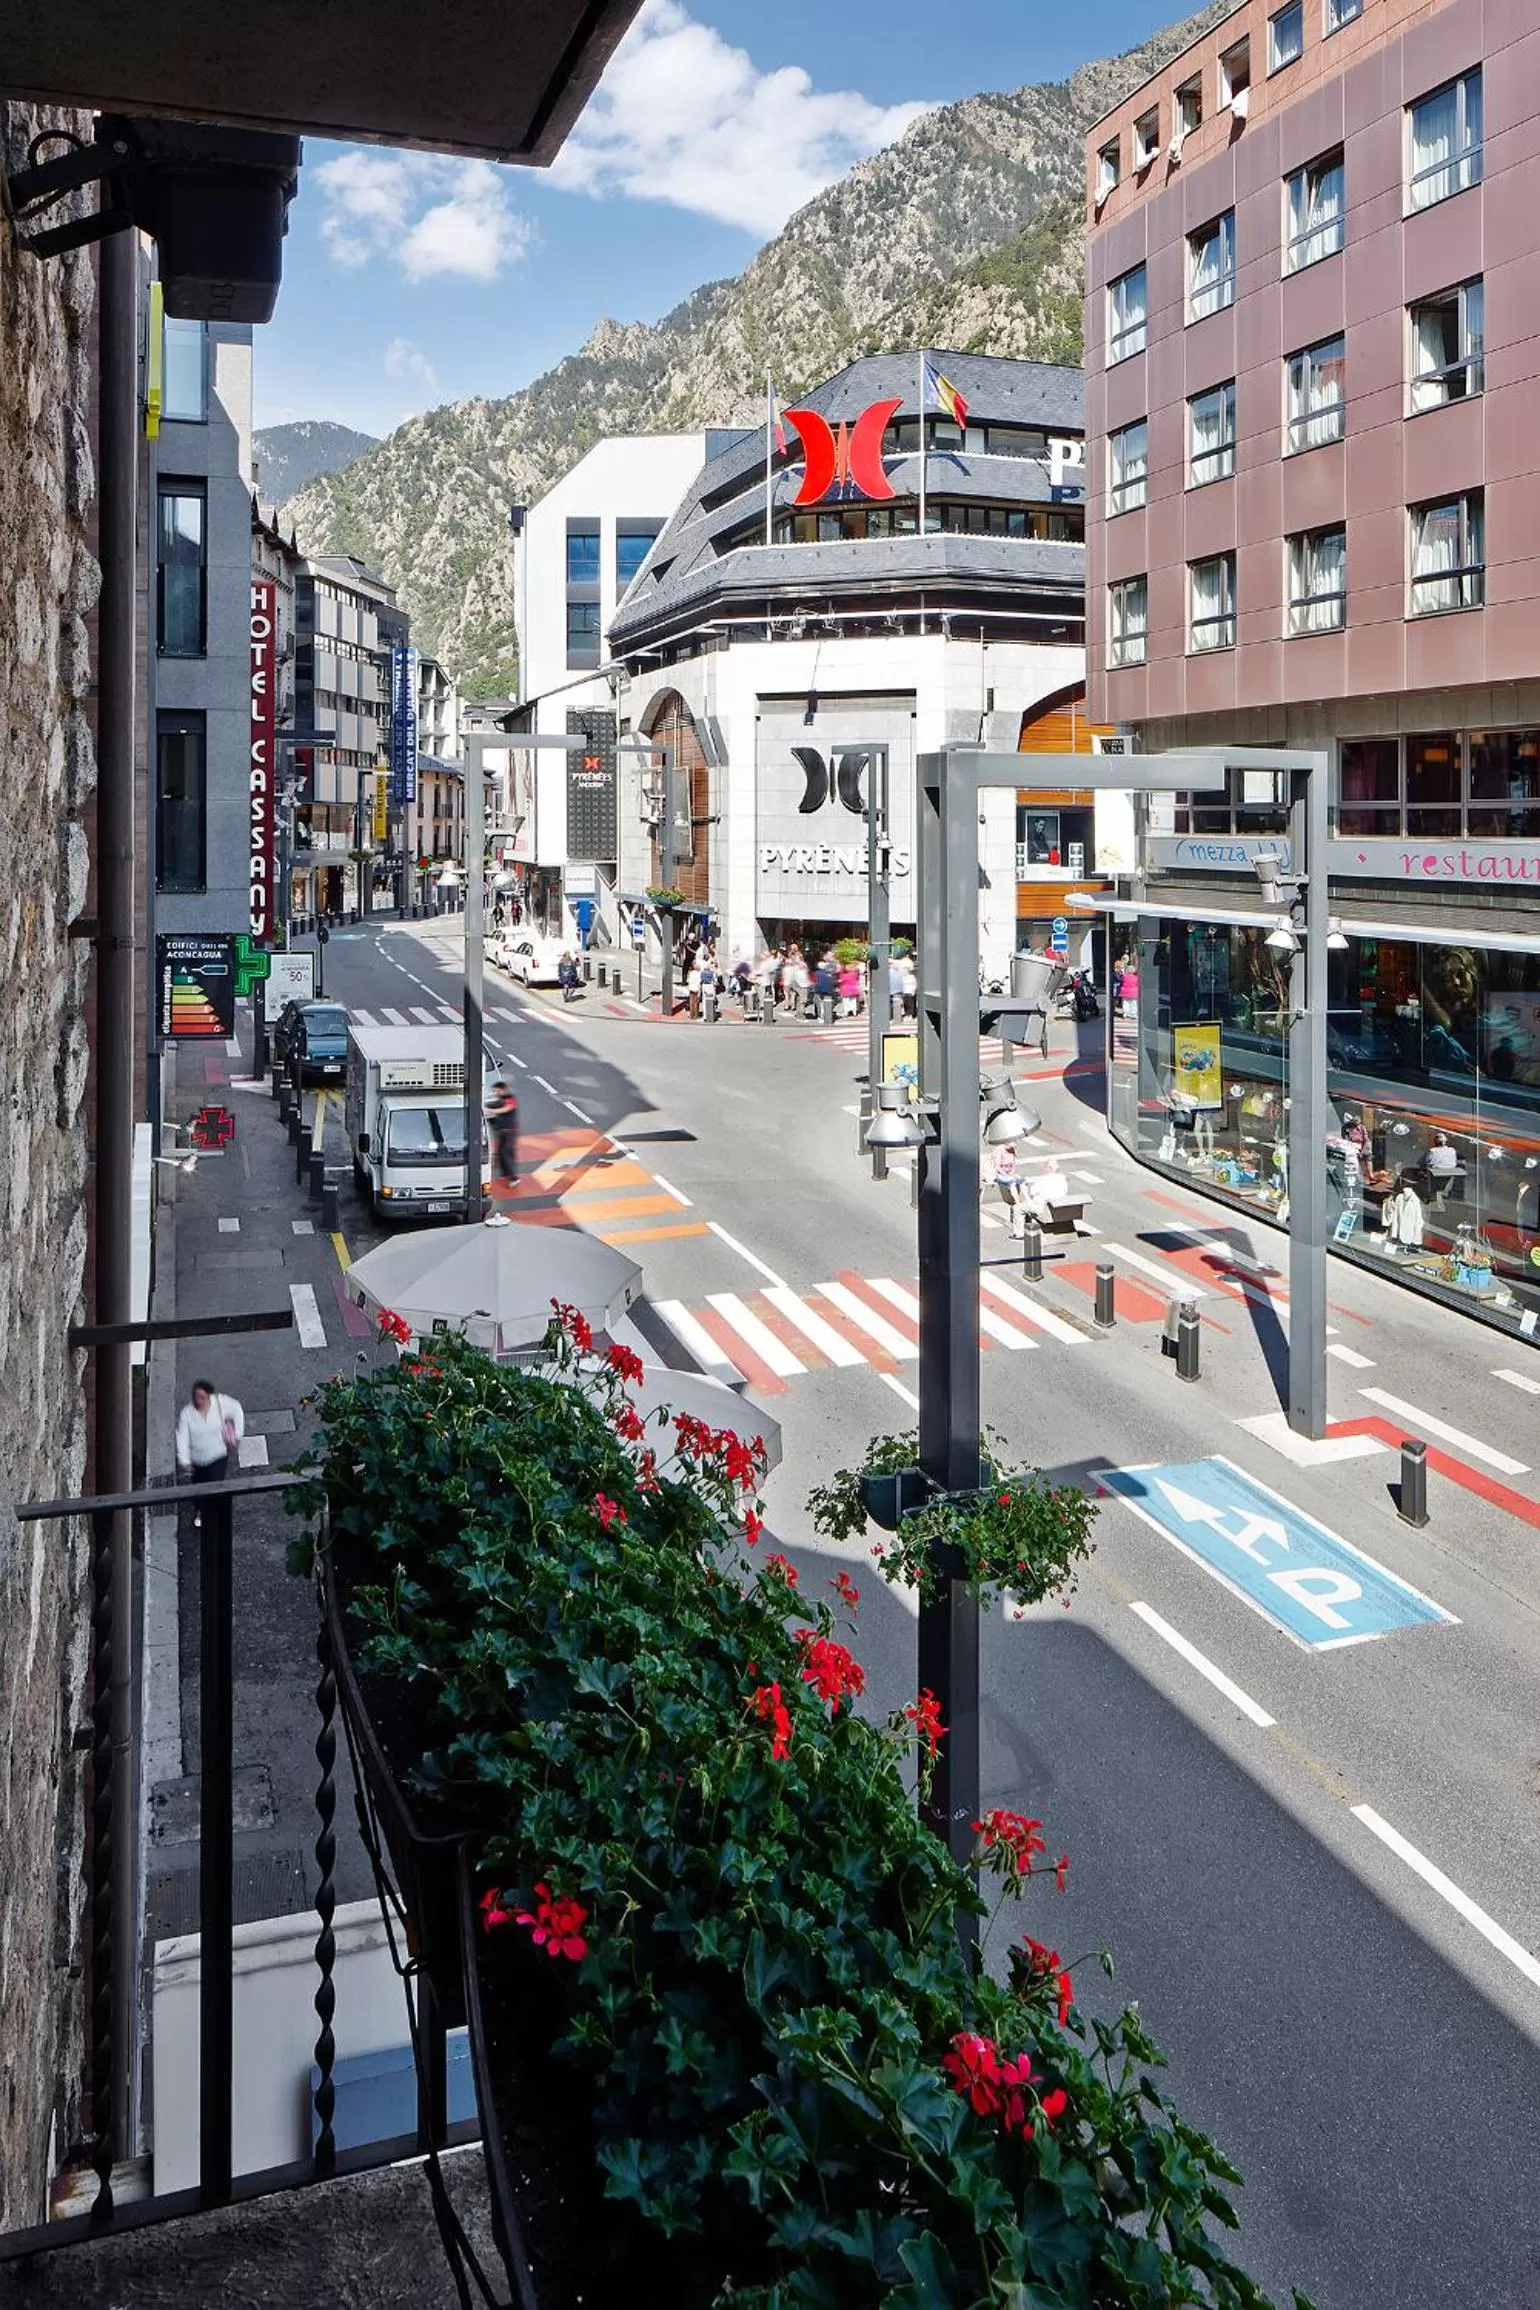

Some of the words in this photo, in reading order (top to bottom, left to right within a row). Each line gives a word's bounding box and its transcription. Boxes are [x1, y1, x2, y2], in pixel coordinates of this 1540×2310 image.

[1047, 438, 1086, 486] P
[250, 587, 272, 722] HOTEL
[250, 740, 266, 937] CASSANY
[1188, 844, 1249, 863] mezza
[166, 942, 198, 950] EDIFICI
[166, 951, 222, 959] ACONCAGUA
[180, 966, 188, 974] A
